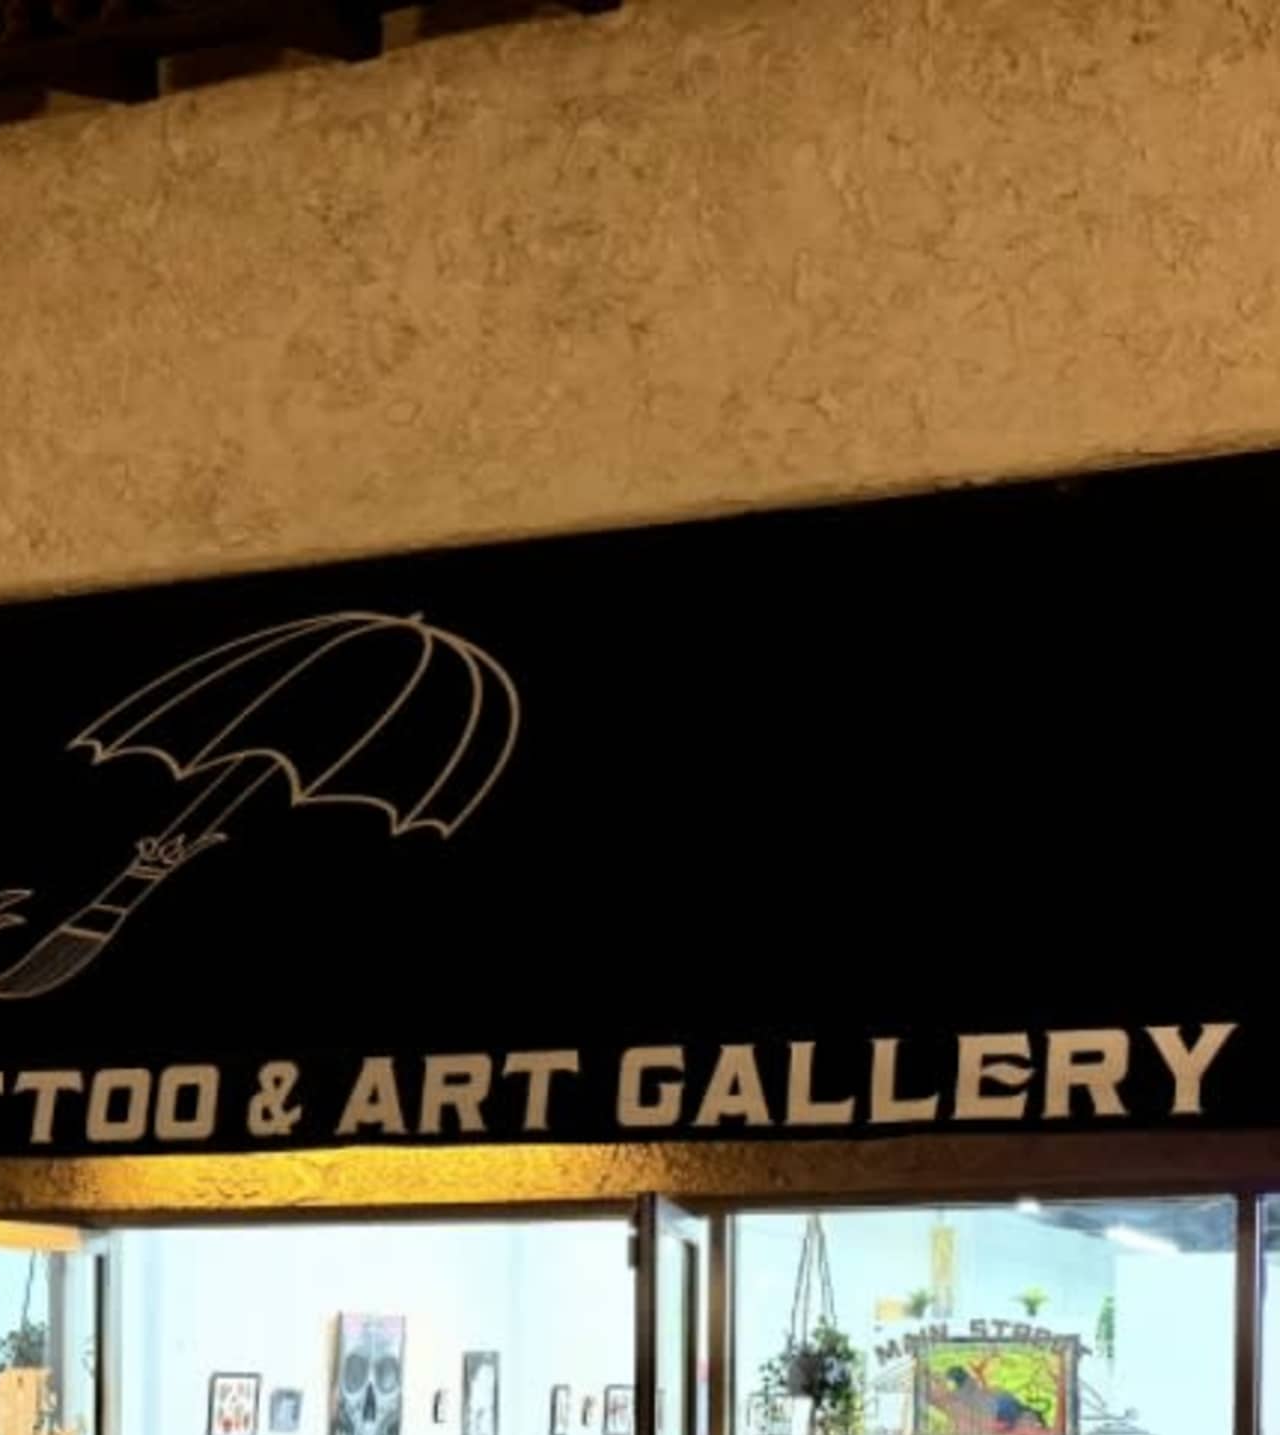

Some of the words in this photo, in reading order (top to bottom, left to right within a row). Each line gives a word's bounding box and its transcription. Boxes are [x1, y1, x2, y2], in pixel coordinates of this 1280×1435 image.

[247, 1061, 303, 1136] &
[335, 1049, 579, 1136] ART
[616, 1023, 1238, 1128] GALLERY
[969, 1317, 1093, 1356] STRET
